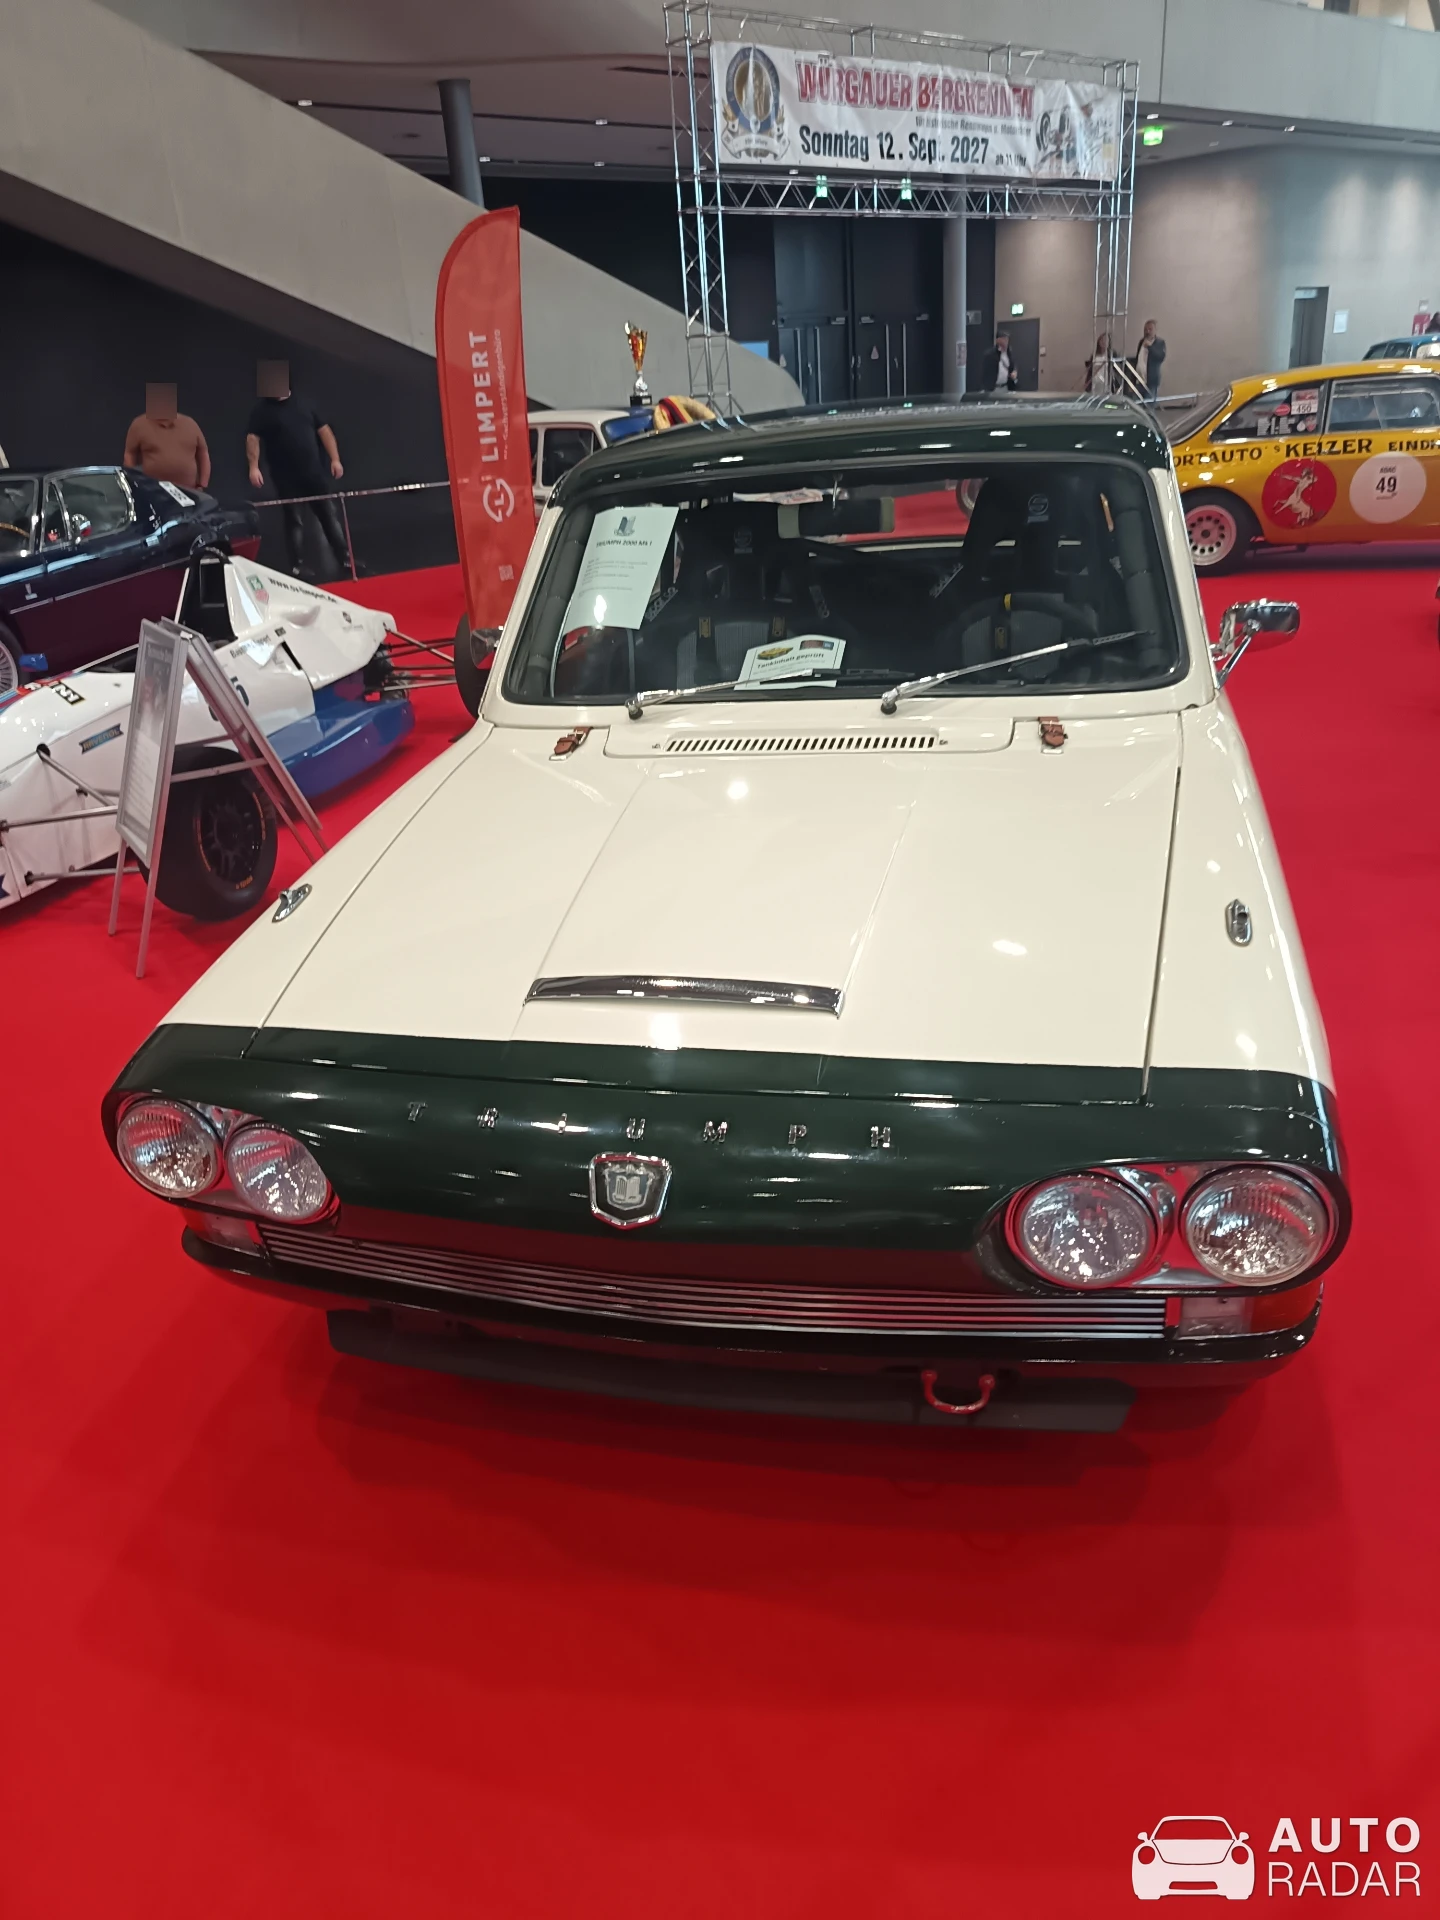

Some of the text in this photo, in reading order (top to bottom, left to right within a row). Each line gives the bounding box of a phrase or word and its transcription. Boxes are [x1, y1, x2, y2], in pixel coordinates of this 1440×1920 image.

[796, 56, 1034, 121] WÜRGAUER BERGRENNEN
[799, 124, 869, 162] Sonntag
[877, 131, 903, 160] 12.
[951, 136, 989, 164] 2027
[469, 330, 499, 462] LIMPERT
[1285, 438, 1373, 458] KEIZER
[1375, 476, 1397, 493] 49
[408, 1101, 892, 1148] TRIUMPH
